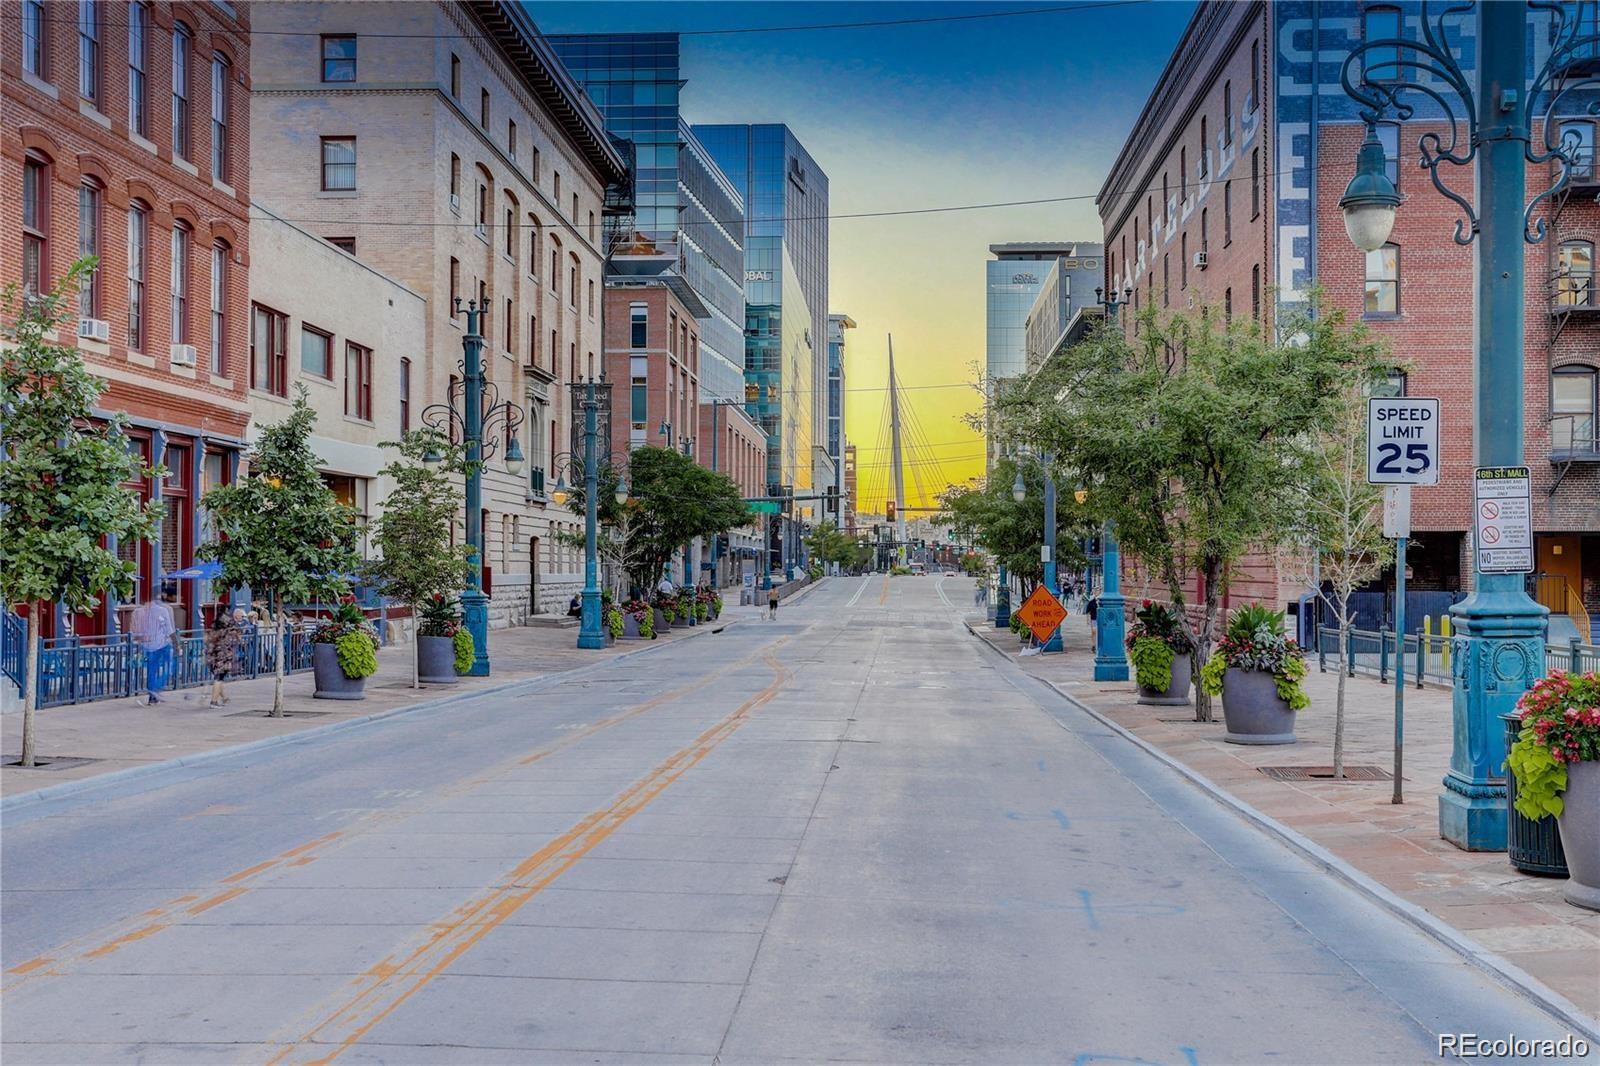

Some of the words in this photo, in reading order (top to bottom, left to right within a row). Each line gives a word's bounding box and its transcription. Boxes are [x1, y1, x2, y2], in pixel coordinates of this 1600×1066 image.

[575, 391, 607, 400] Tatred
[1377, 408, 1432, 421] SPEED
[1383, 426, 1424, 439] LIMIT
[1376, 443, 1431, 474] 25
[1507, 469, 1528, 477] MALL
[1481, 552, 1491, 564] NO
[1033, 610, 1052, 618] WORK
